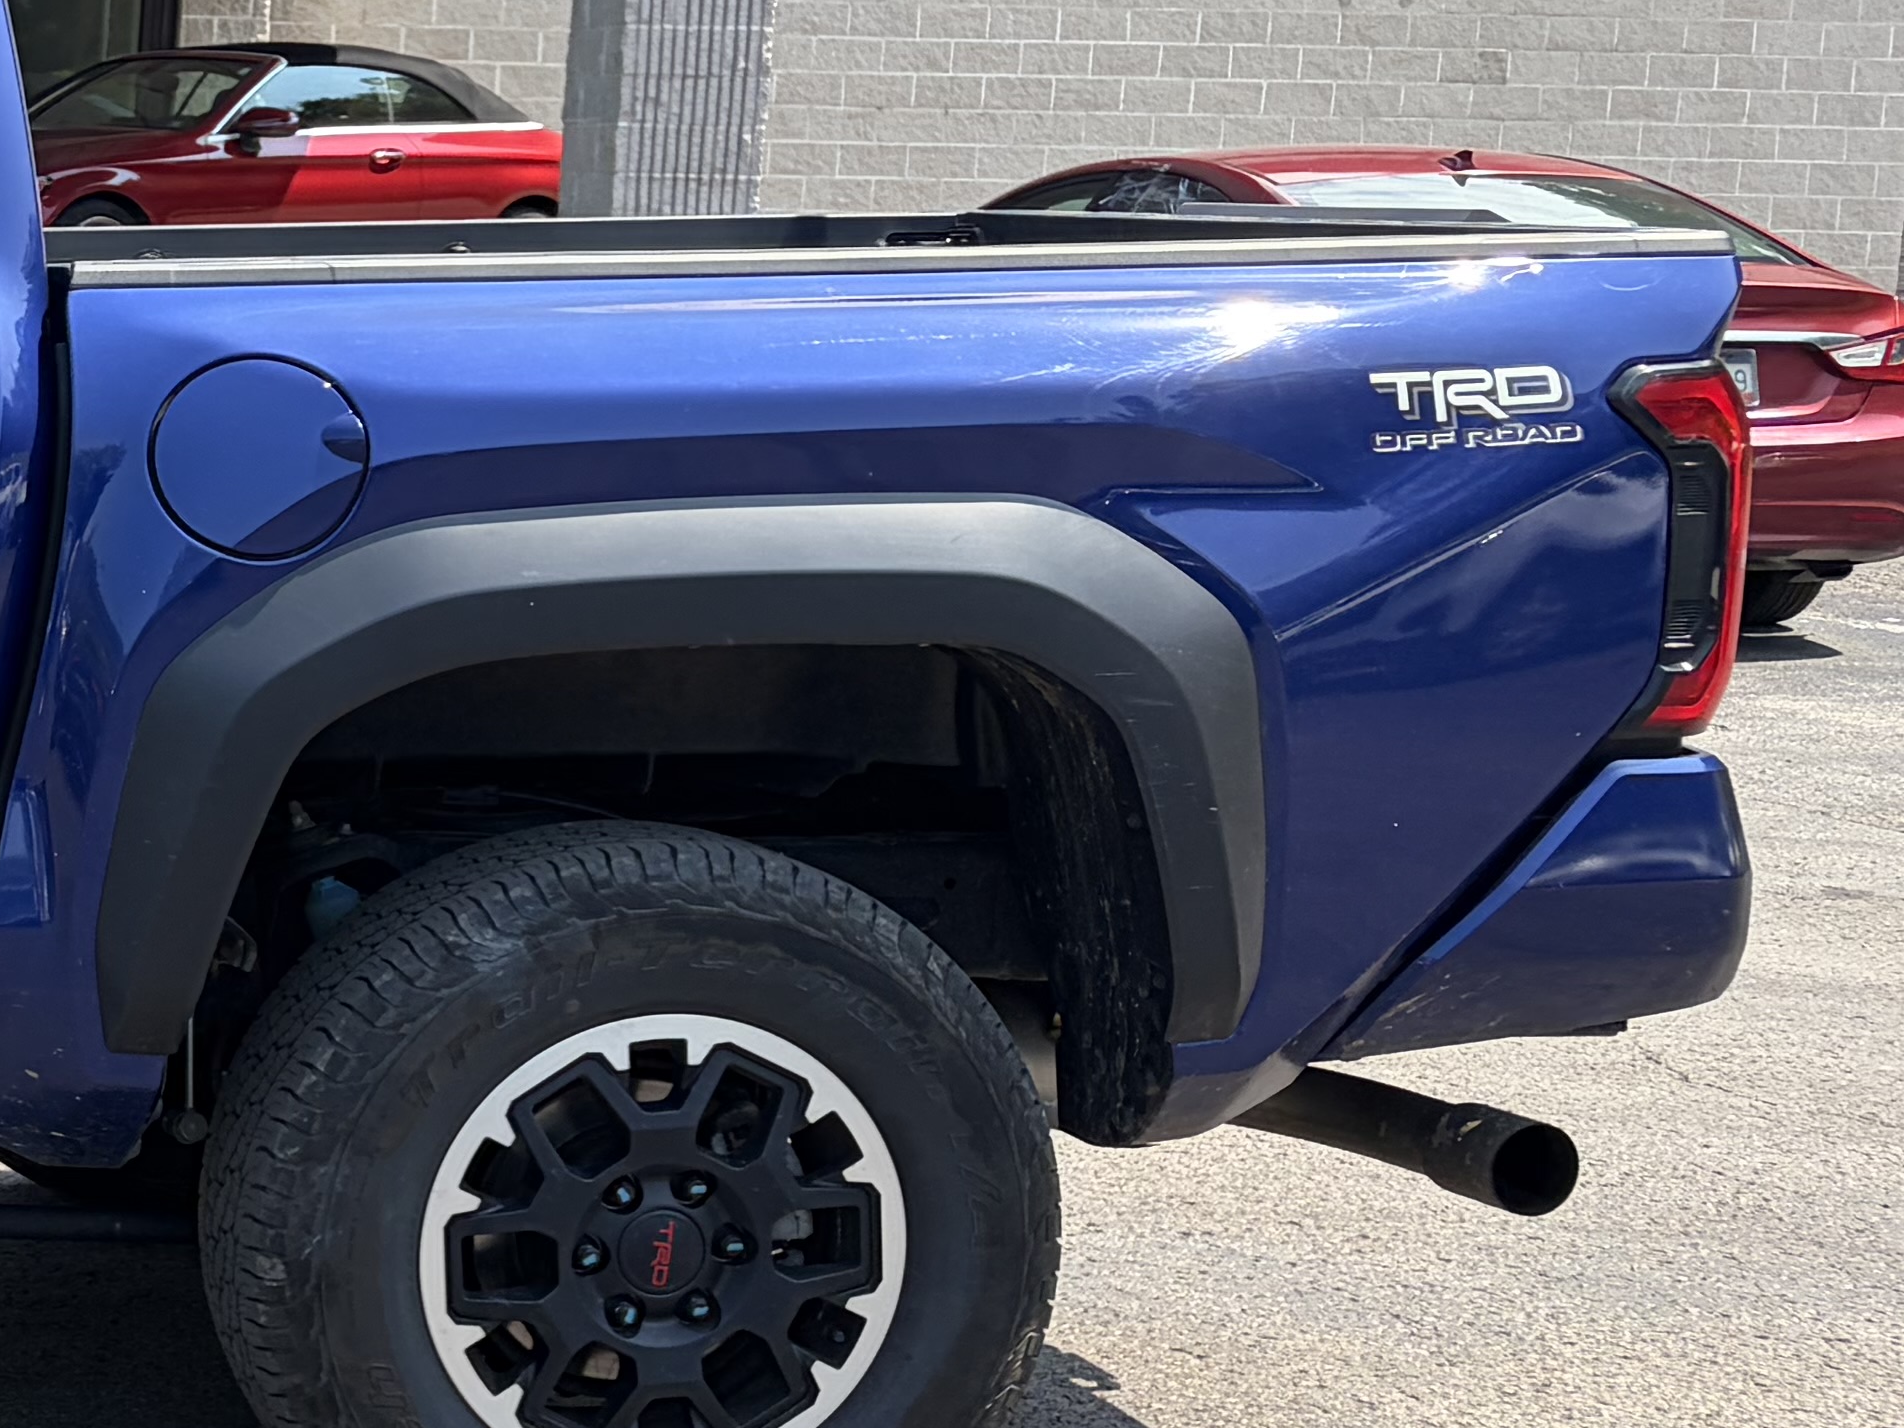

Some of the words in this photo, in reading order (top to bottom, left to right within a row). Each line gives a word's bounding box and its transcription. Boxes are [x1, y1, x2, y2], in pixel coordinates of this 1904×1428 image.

[1369, 365, 1574, 429] TRD
[1370, 429, 1458, 453] OFF
[1463, 422, 1585, 448] ROAD
[651, 1221, 676, 1288] TRD
